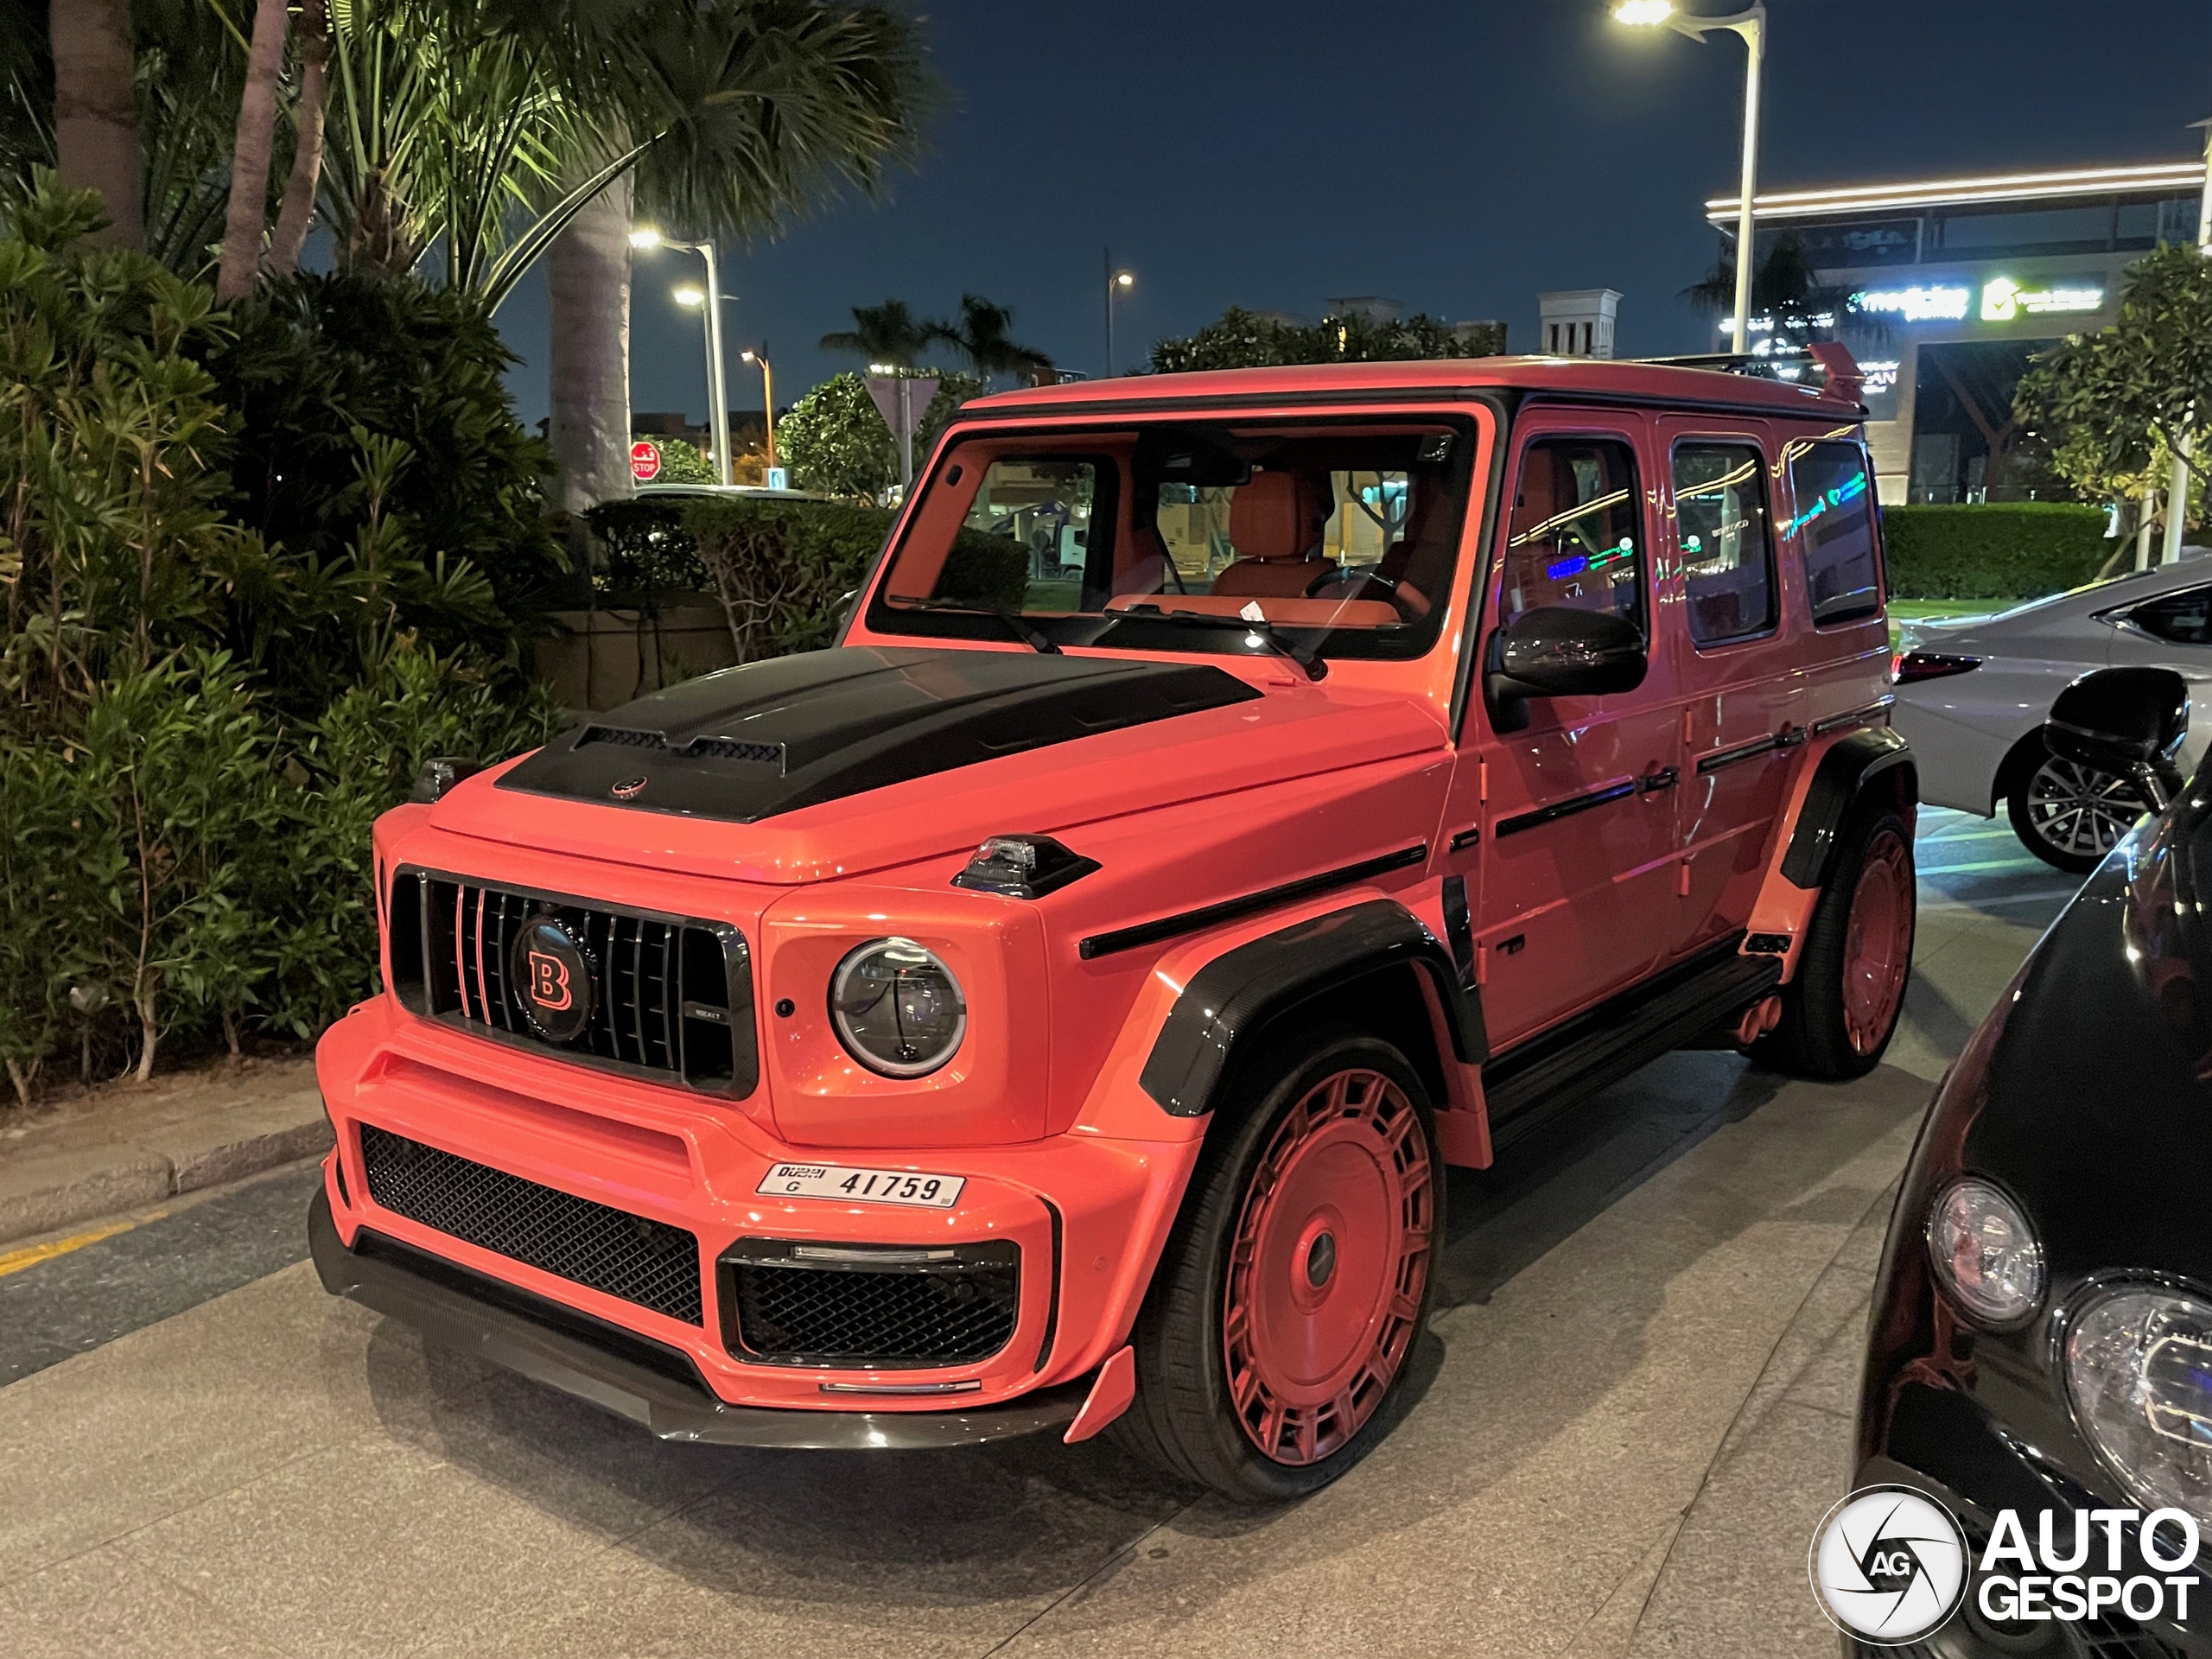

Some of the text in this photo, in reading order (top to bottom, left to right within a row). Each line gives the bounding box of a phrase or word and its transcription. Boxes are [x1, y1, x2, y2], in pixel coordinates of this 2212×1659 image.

[632, 447, 655, 461] قف
[633, 463, 656, 473] STOP
[529, 950, 573, 1011] B
[785, 1180, 802, 1192] G
[839, 1173, 943, 1200] 41759
